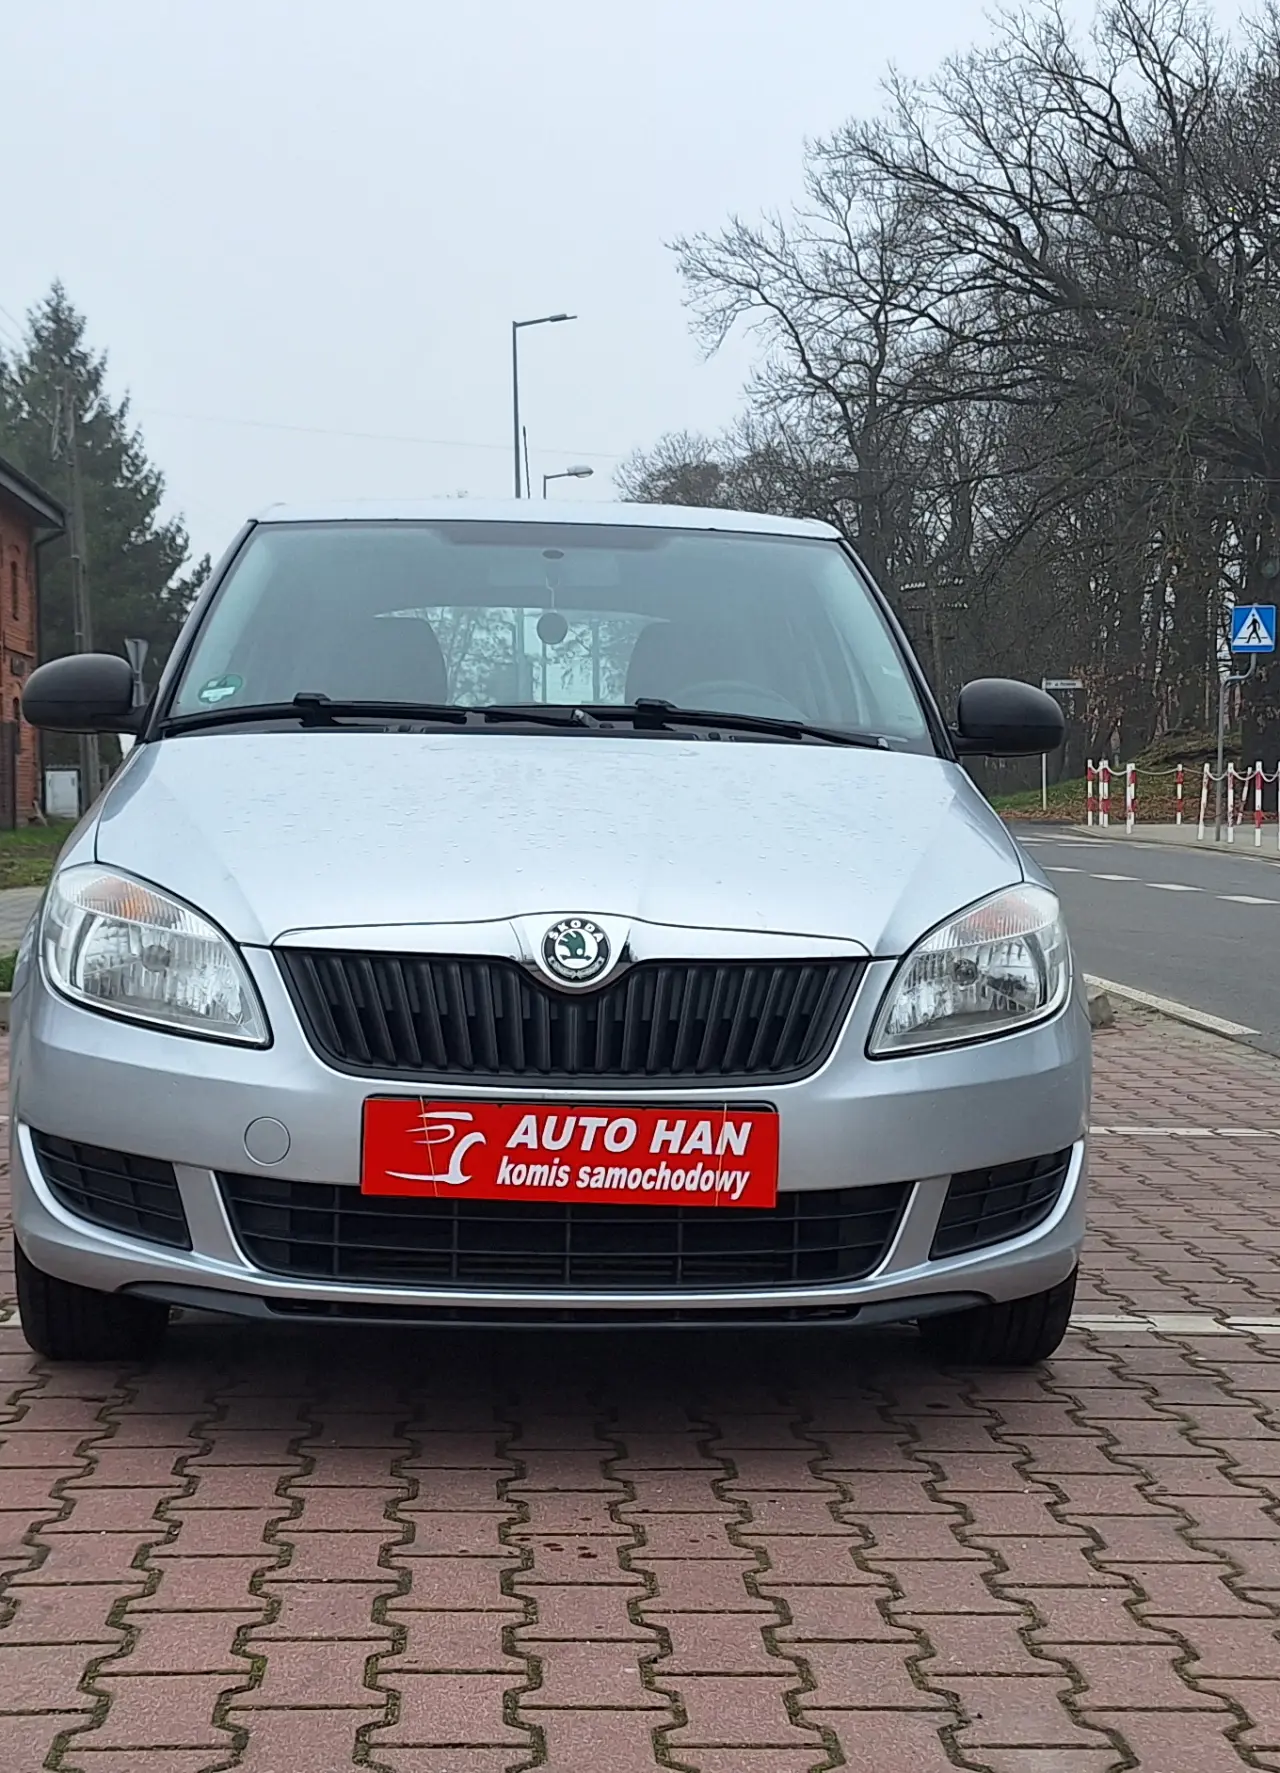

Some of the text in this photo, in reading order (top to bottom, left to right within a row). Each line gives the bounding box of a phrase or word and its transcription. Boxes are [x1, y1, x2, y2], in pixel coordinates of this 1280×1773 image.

[506, 1114, 752, 1156] AUTO HAN
[496, 1156, 750, 1200] komis samochodowy
